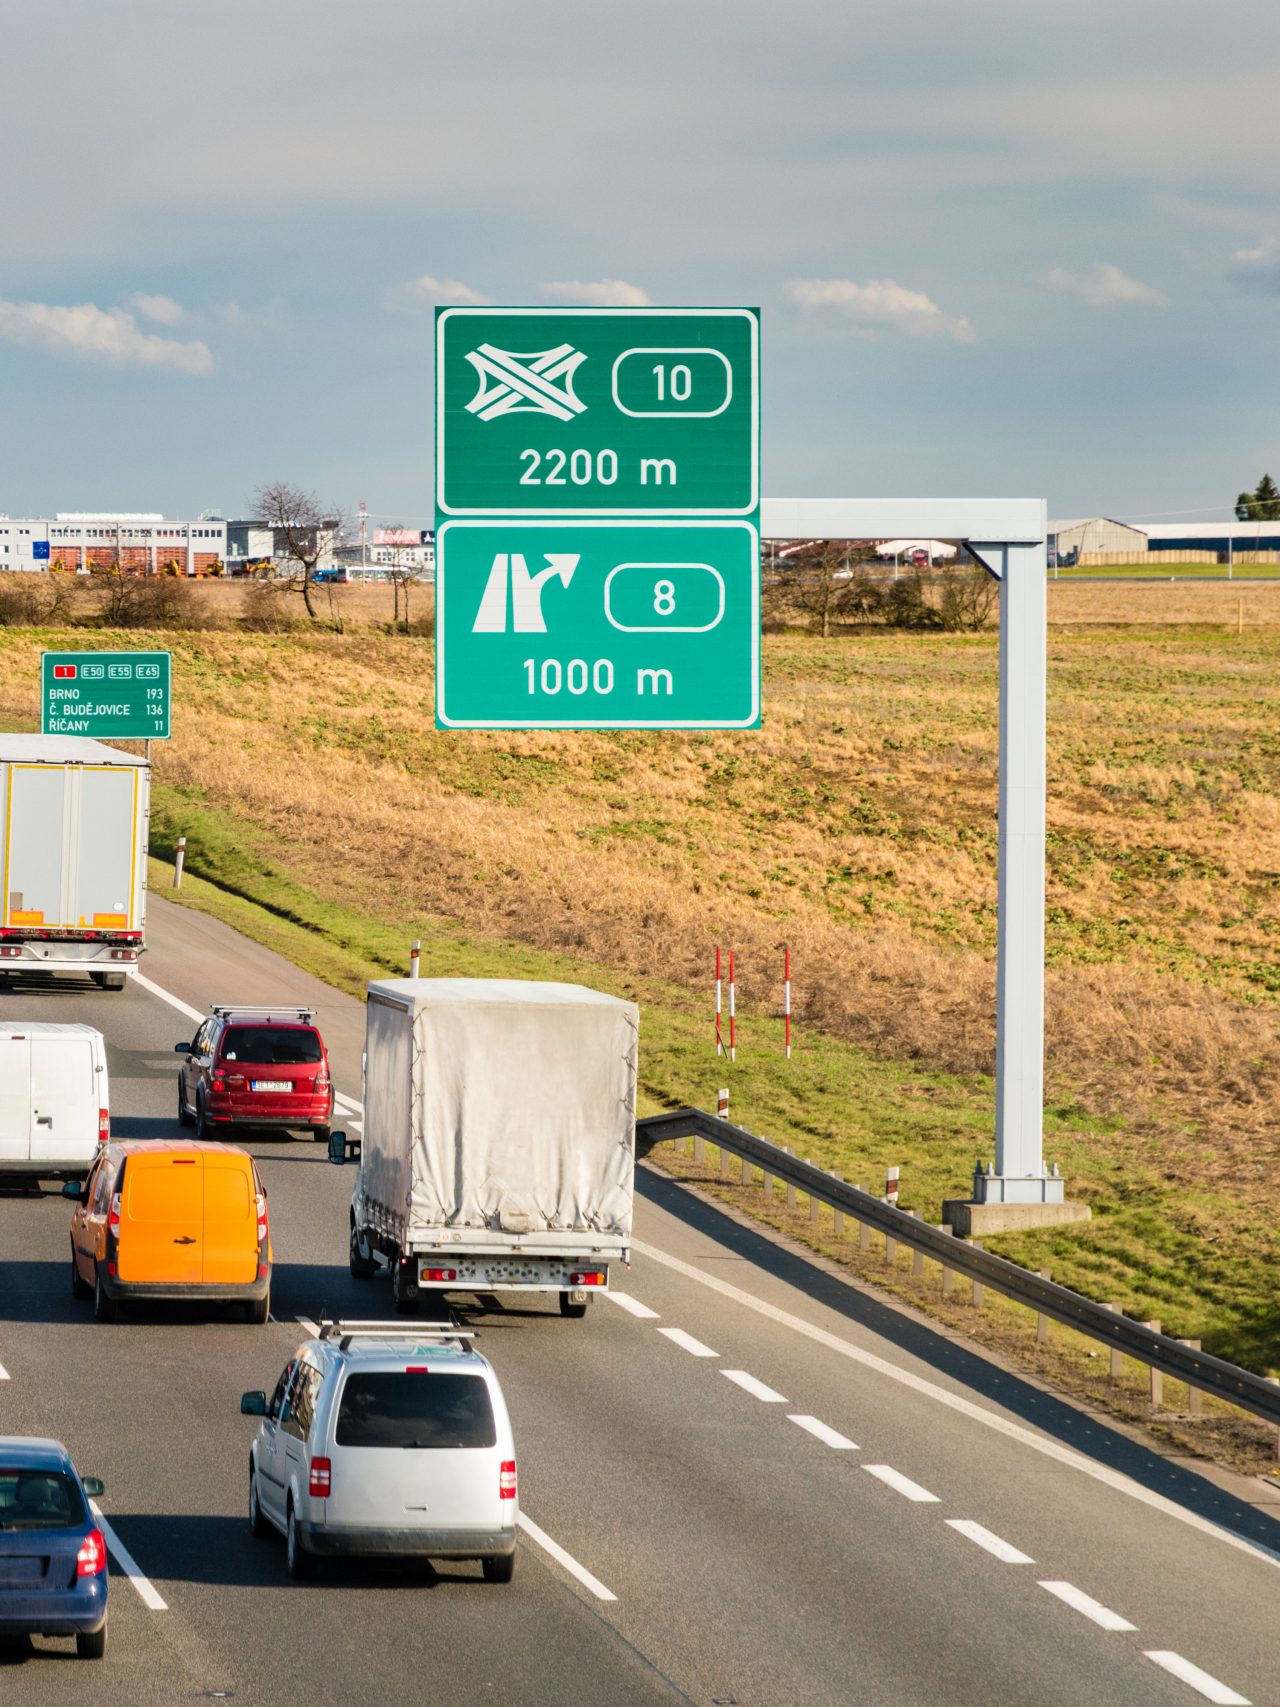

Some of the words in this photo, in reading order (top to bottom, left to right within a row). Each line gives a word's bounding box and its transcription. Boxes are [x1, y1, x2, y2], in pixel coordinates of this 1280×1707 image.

[653, 364, 692, 401] 10
[519, 448, 618, 485] 2200
[640, 458, 677, 485] m
[653, 579, 676, 616] 8
[64, 667, 68, 676] 1
[523, 658, 615, 695] 1000
[637, 667, 673, 695] m
[49, 689, 80, 699] BRNO
[146, 689, 163, 699] 193
[49, 703, 59, 715] Č.
[63, 703, 130, 715] BUDĚJOVICE
[146, 704, 163, 715] 136
[49, 718, 90, 731] ŘÍČANY
[154, 720, 163, 731] 11
